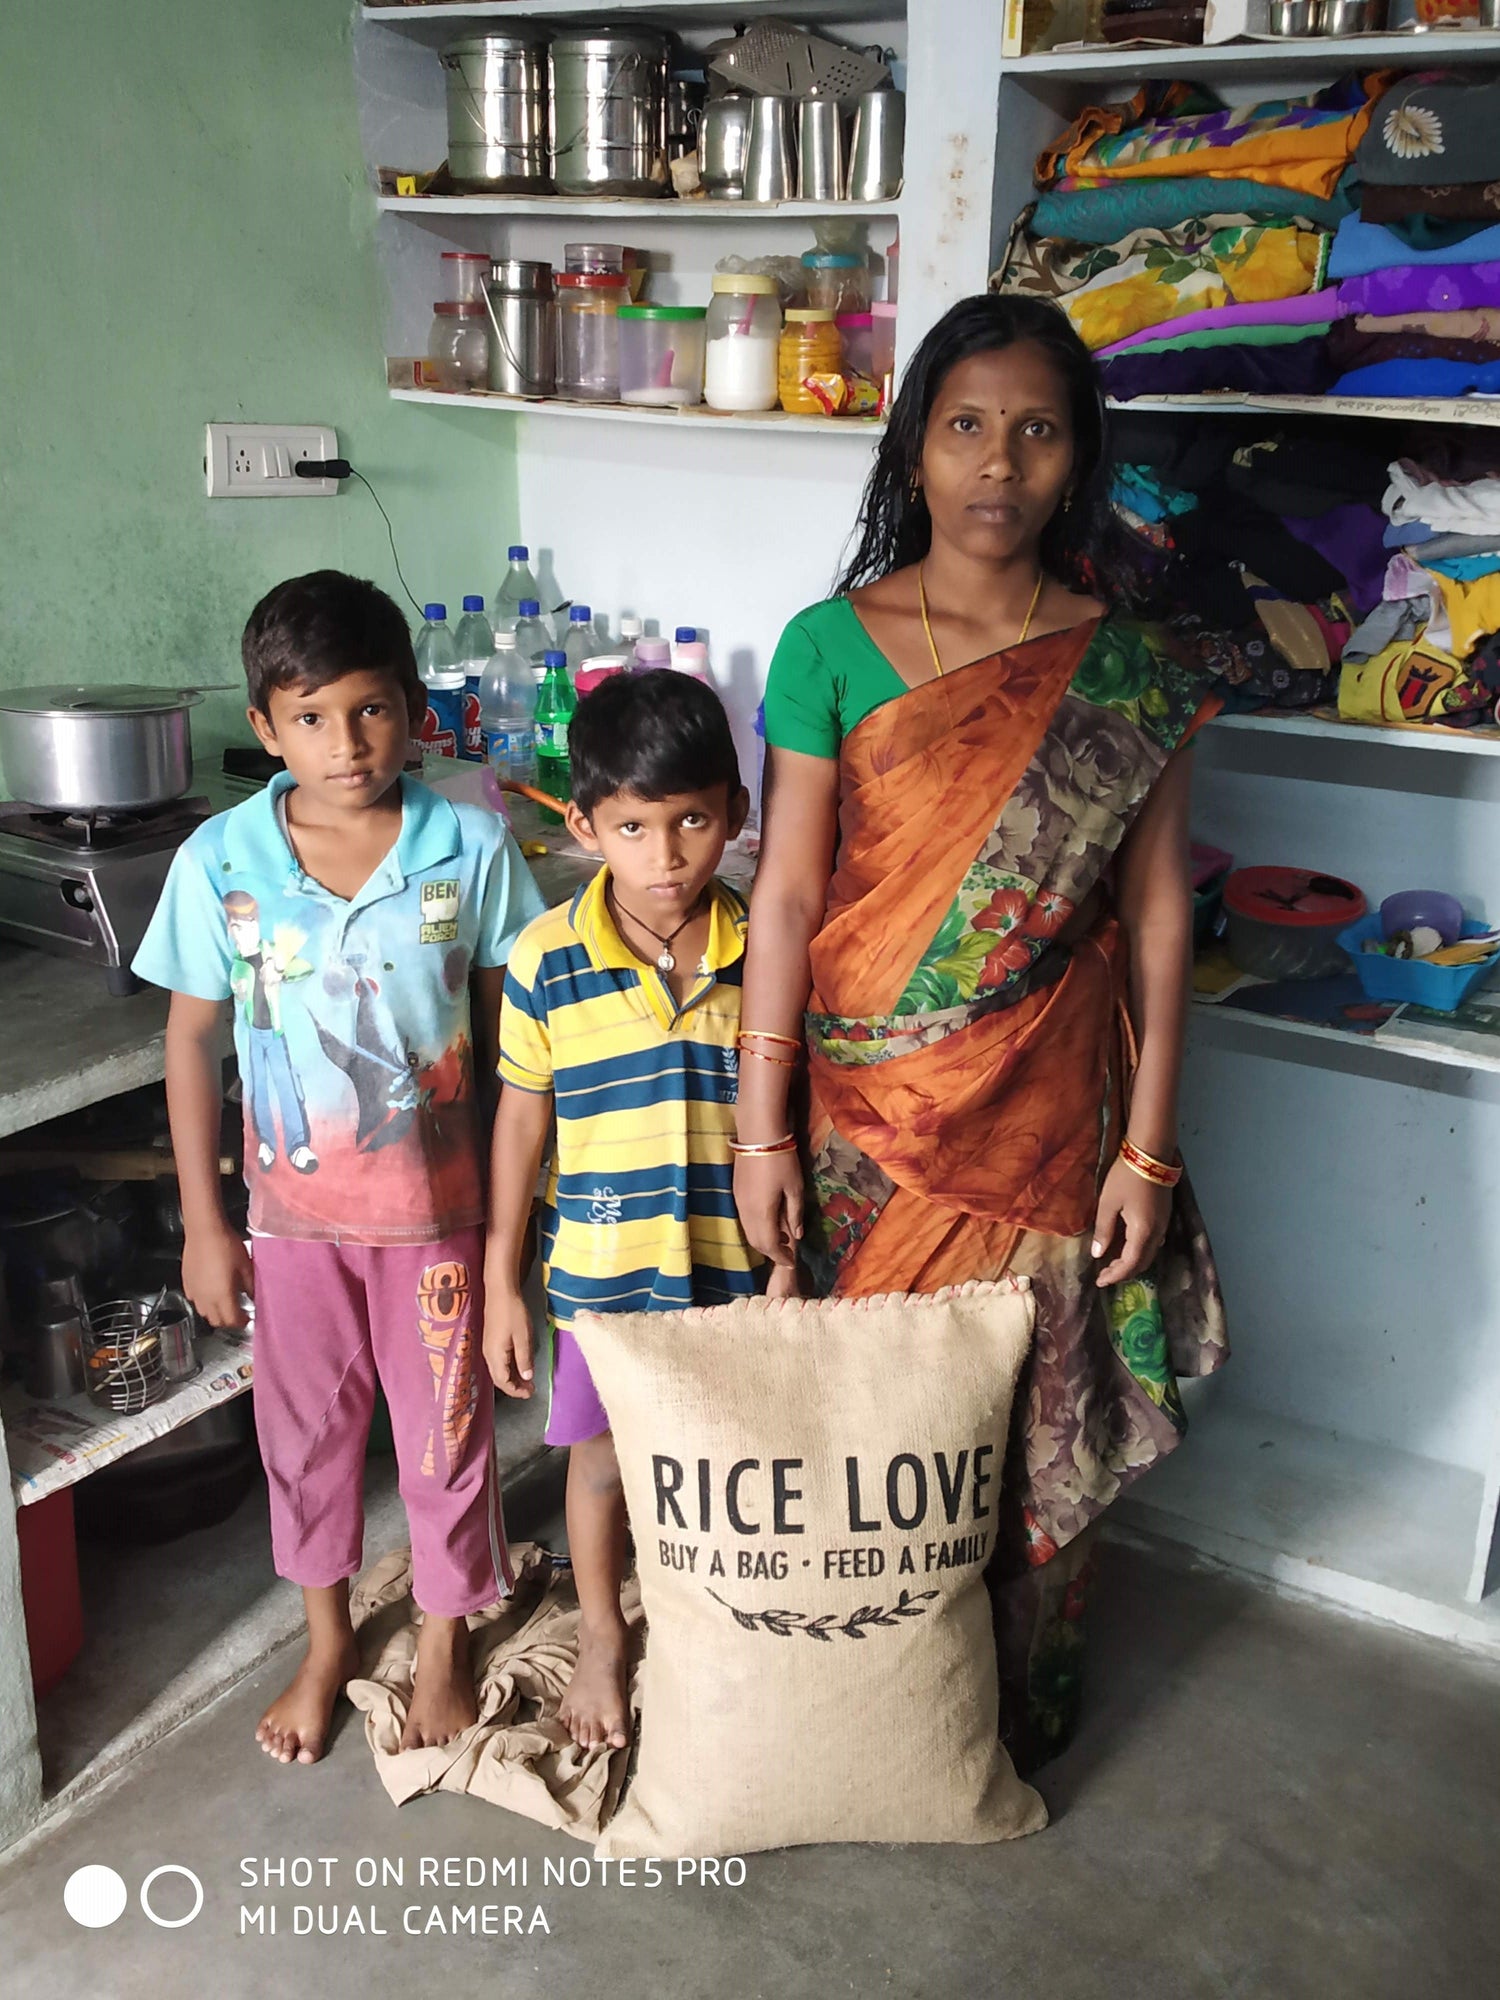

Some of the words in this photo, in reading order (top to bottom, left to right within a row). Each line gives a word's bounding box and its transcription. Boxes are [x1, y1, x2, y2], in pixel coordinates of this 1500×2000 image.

[424, 882, 458, 902] BEN
[652, 1454, 805, 1535] RICE
[846, 1445, 993, 1532] LOVE
[659, 1539, 699, 1573] BUY
[709, 1549, 726, 1578] A
[737, 1550, 789, 1580] BAG
[824, 1547, 885, 1579] FEED
[898, 1545, 915, 1575] A
[925, 1532, 988, 1573] FAMILY
